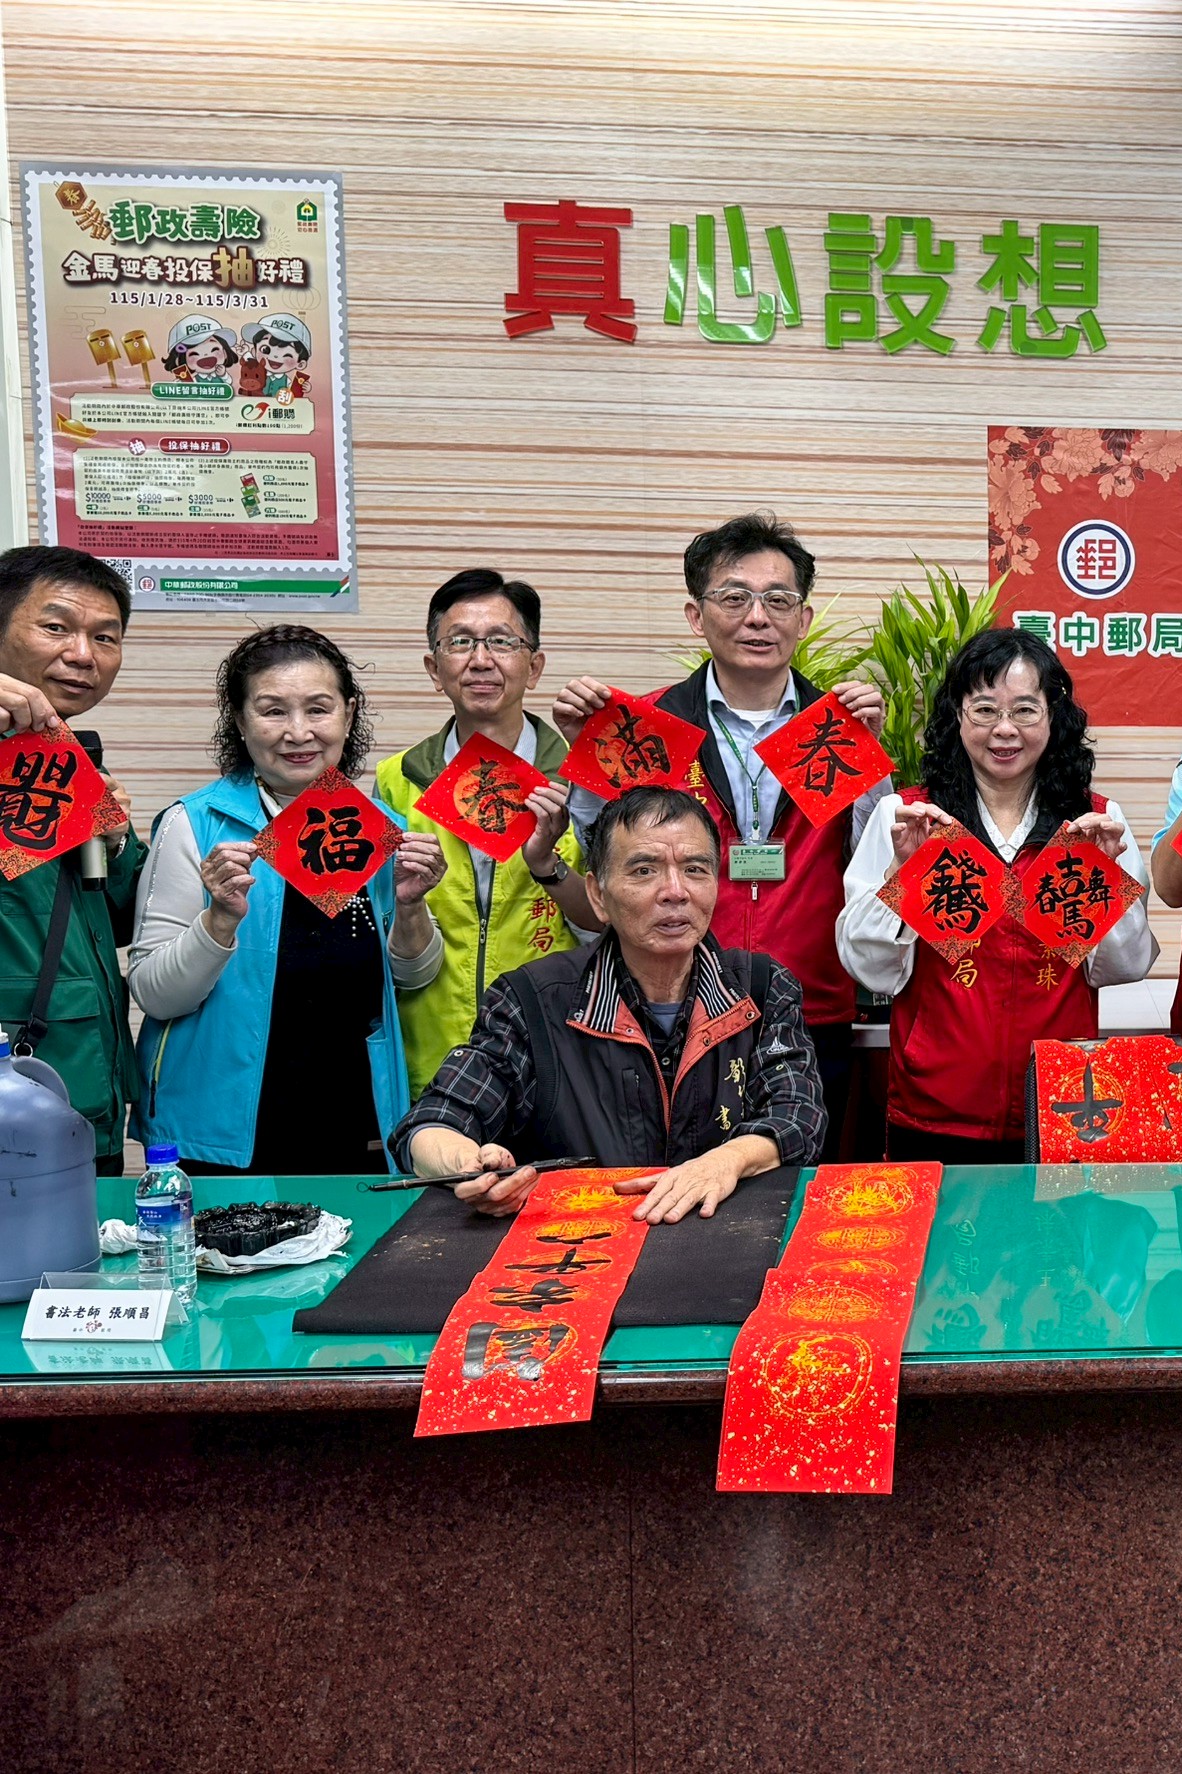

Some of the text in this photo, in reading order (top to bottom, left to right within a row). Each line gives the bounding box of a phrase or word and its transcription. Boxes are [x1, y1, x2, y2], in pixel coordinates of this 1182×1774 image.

[109, 201, 260, 241] 郵政壽險
[63, 247, 305, 287] 金馬迎春投保抽好禮
[503, 200, 1108, 357] 真心設想
[110, 291, 269, 308] 115/1/28~115/3/31
[185, 322, 213, 336] POST
[270, 319, 296, 331] POST
[130, 438, 146, 454] 抽
[168, 441, 222, 453] 投保抽好禮
[1076, 538, 1117, 580] 郵
[788, 707, 863, 797] 春
[298, 806, 375, 875] 福
[528, 897, 558, 954] 郵局
[45, 1304, 151, 1320] 書法老師 張順昌
